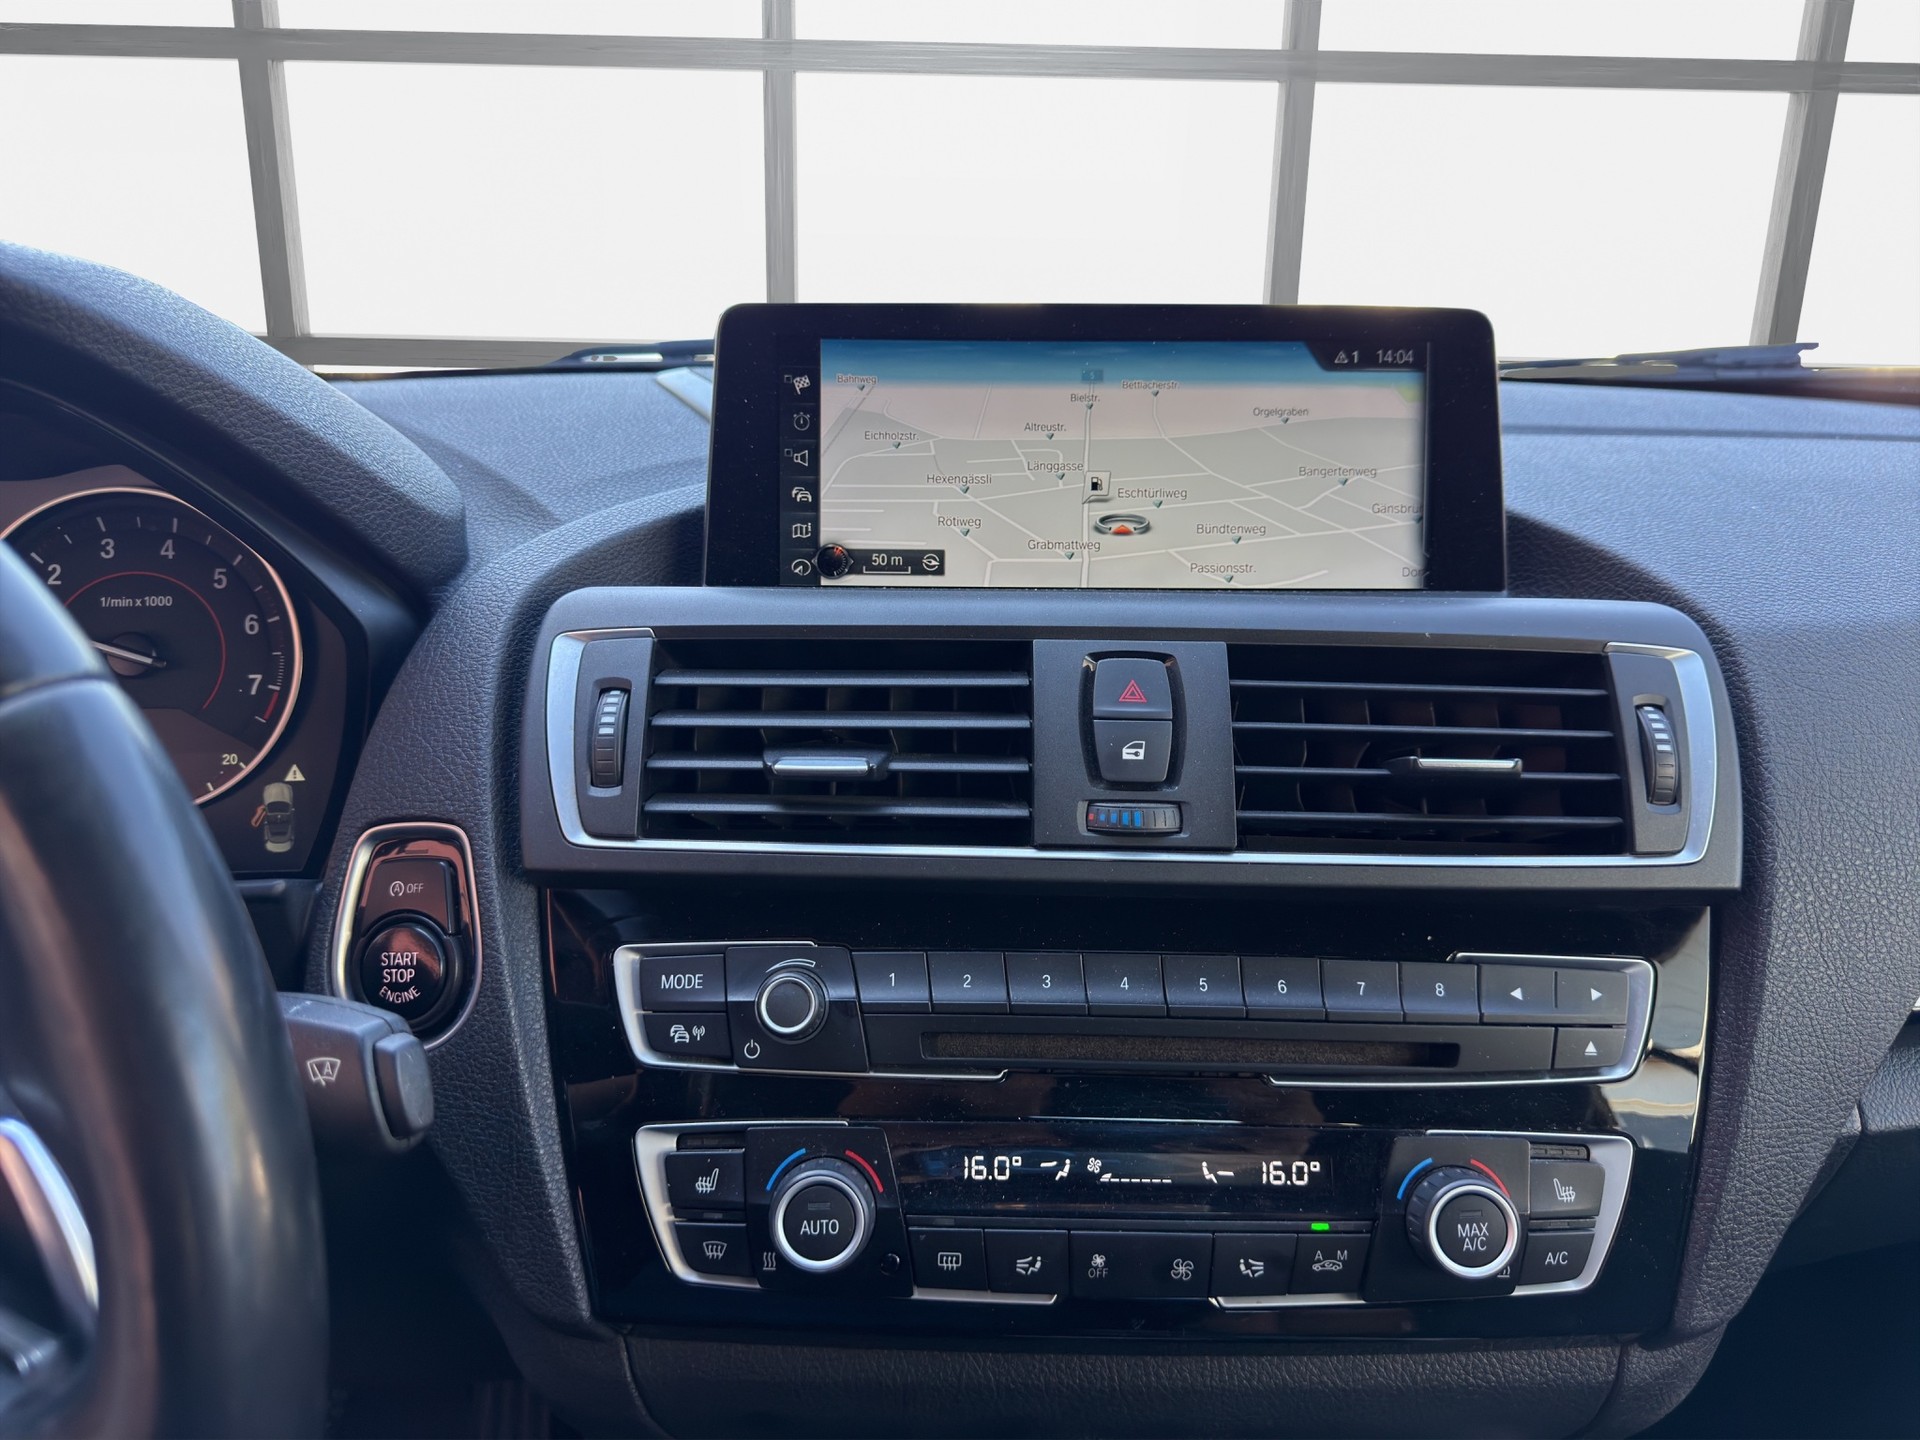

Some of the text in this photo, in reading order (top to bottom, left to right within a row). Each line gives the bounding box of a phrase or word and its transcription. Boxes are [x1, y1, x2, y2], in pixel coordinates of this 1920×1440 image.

[1351, 351, 1359, 363] 1
[1376, 351, 1414, 363] 14:04
[837, 375, 877, 385] Bahnweg
[1070, 393, 1100, 402] Bielstr.
[1253, 408, 1309, 418] Orgelgraben
[1024, 422, 1066, 432] Altreustr.
[864, 430, 919, 440] Eichholzstr.
[1027, 461, 1084, 473] Länggasse
[1299, 466, 1377, 479] Bangertenweg
[926, 474, 992, 486] Hexengässli
[1118, 487, 1187, 500] Eschtürliweg
[1196, 524, 1266, 536] Bündtenweg
[100, 538, 115, 559] 3
[160, 538, 175, 559] 4
[1027, 539, 1101, 551] Grabmattweg
[871, 554, 903, 566] 50 m
[47, 564, 62, 585] 2
[1190, 563, 1256, 573] Passionsstr.
[213, 568, 228, 589] 5
[100, 596, 133, 607] 1/min
[144, 596, 173, 607] 1000
[244, 614, 259, 635] 6
[248, 674, 263, 695] 7
[222, 754, 238, 765] 20
[406, 883, 424, 894] OFF
[381, 952, 419, 966] START
[383, 968, 415, 983] STOP
[660, 973, 704, 990] MODE
[888, 973, 896, 988] 1
[963, 975, 972, 989] 2
[1041, 975, 1051, 989] 3
[1119, 976, 1129, 990] 4
[1199, 978, 1208, 992] 5
[1277, 980, 1287, 994] 6
[1356, 982, 1366, 996] 7
[1435, 983, 1445, 997] 8
[379, 985, 421, 1004] ENGINE
[800, 1219, 839, 1235] AUTO
[1457, 1222, 1489, 1238] MAX
[1462, 1236, 1487, 1252] A/C
[1314, 1249, 1348, 1261] A M
[1545, 1251, 1568, 1266] A/C
[1087, 1268, 1108, 1279] OFF
